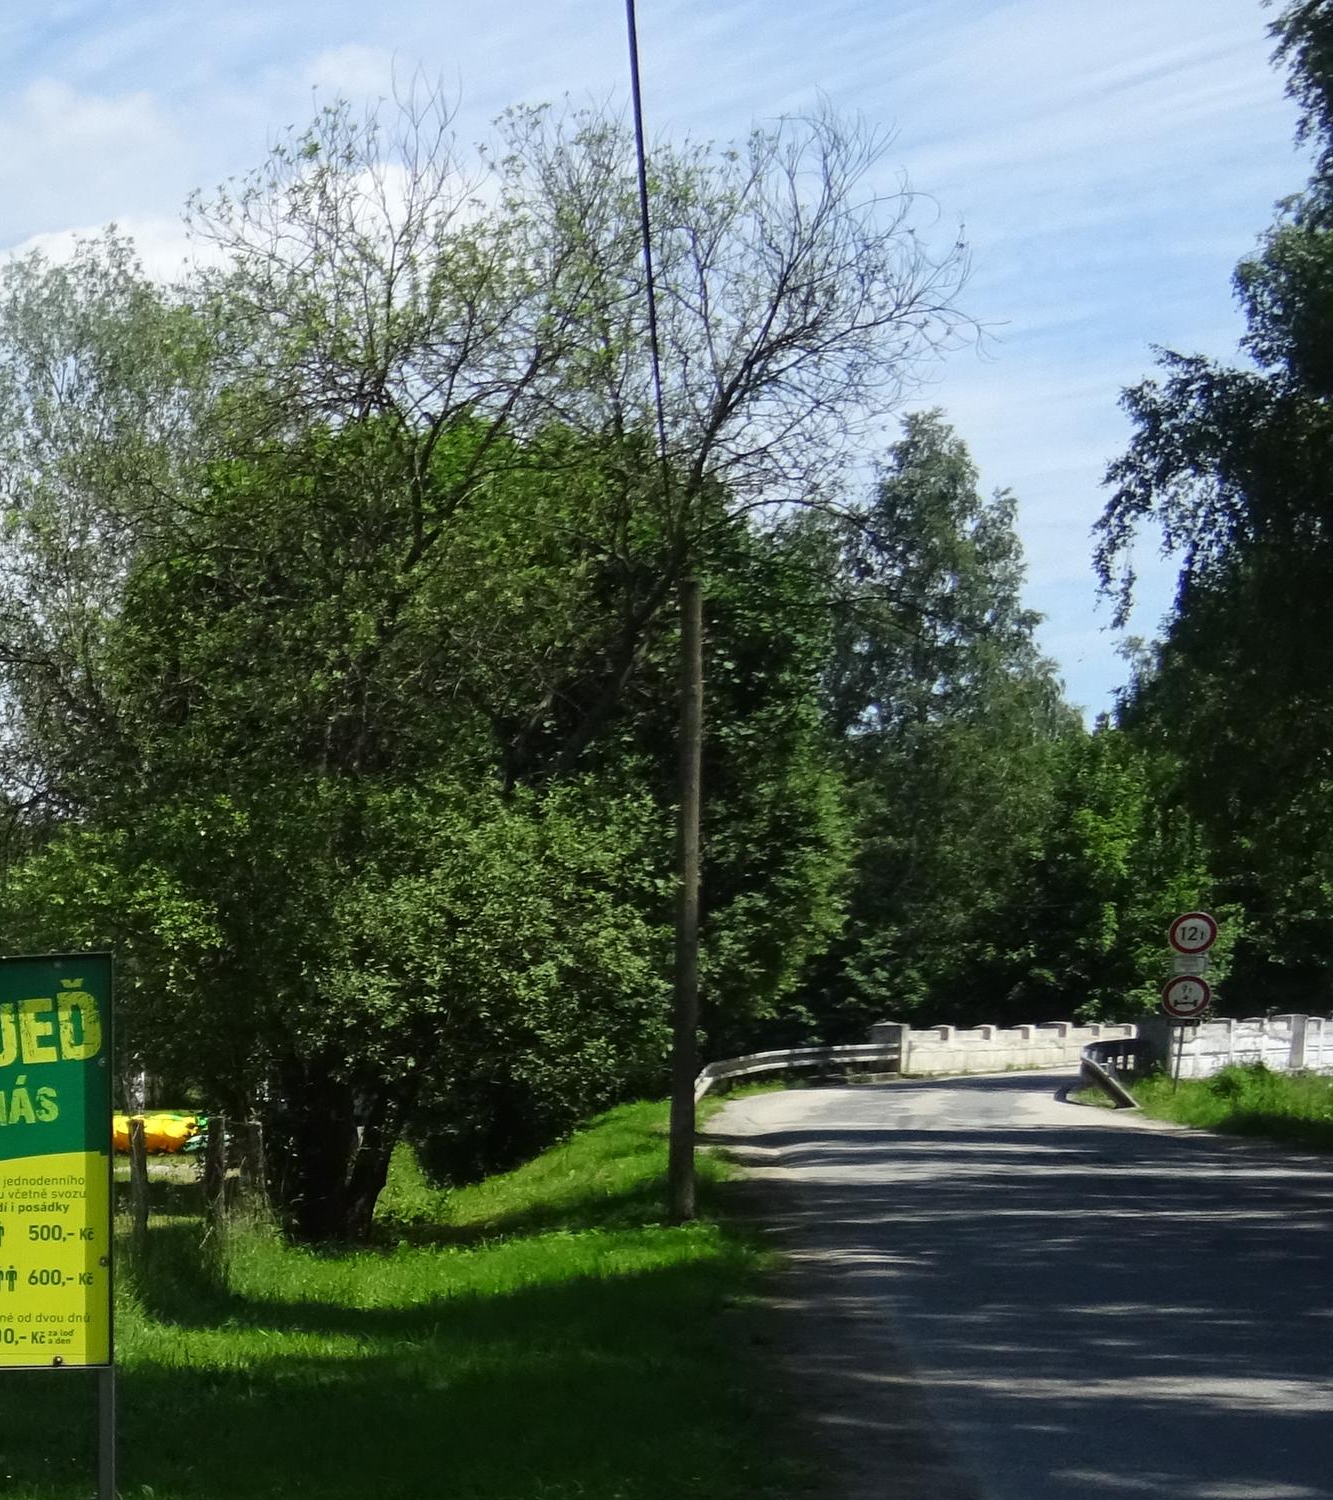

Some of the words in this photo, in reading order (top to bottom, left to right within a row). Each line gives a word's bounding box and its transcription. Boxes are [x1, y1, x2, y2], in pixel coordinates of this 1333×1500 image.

[3, 1175, 85, 1188] jednodenního
[8, 1188, 47, 1200] včetně
[51, 1190, 87, 1199] svozu
[18, 1202, 70, 1214] posádky
[79, 1227, 94, 1241] Kč
[78, 1272, 93, 1285] Kč
[17, 1312, 32, 1323] od
[35, 1312, 64, 1323] dvou
[67, 1312, 91, 1323] dnů
[31, 1331, 46, 1345] Kč
